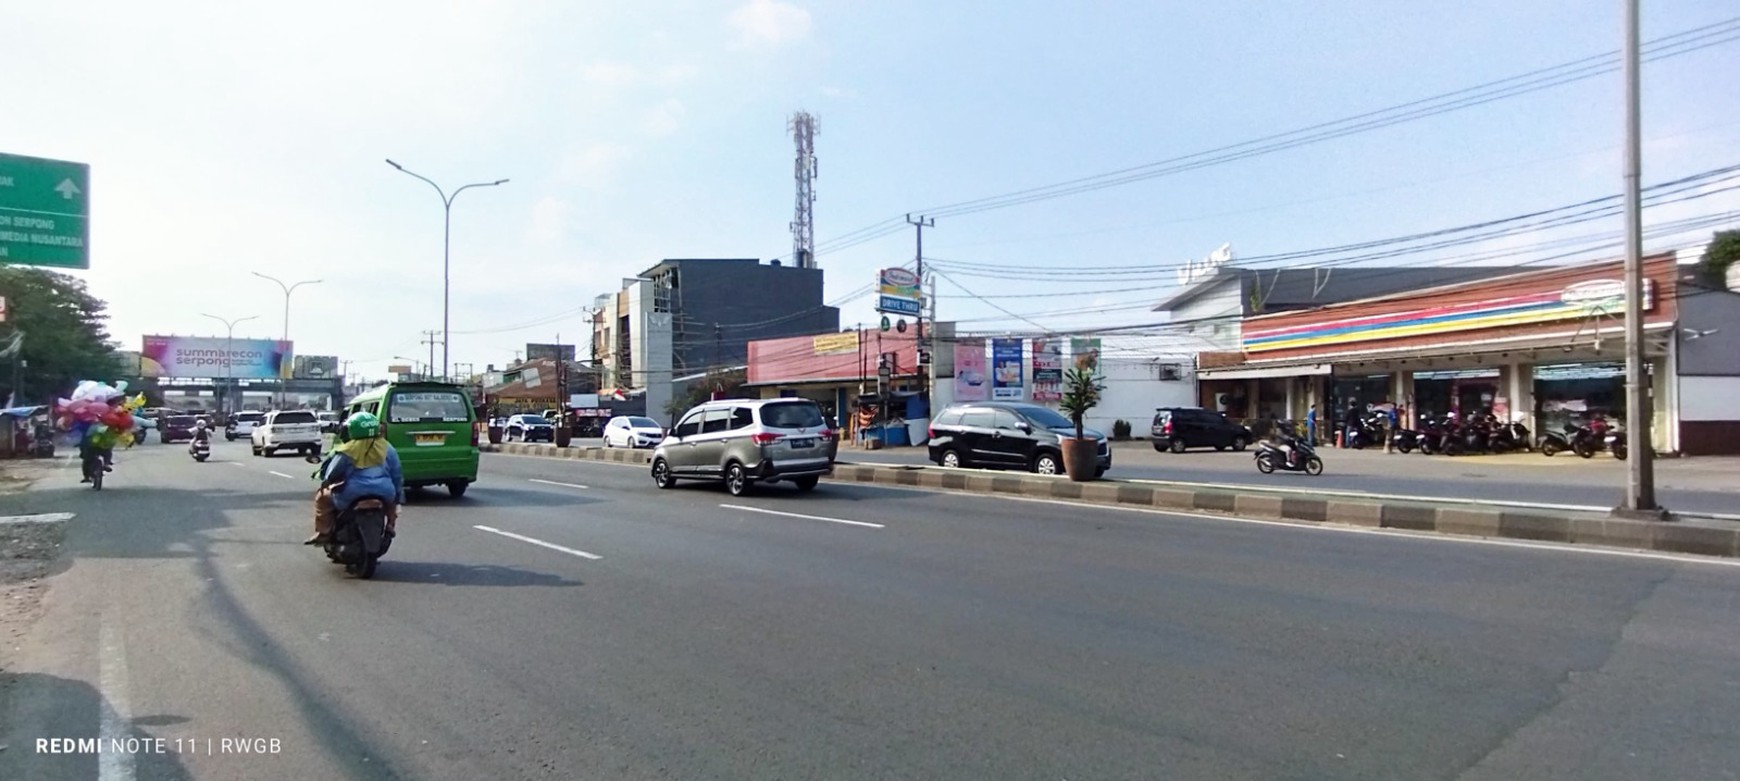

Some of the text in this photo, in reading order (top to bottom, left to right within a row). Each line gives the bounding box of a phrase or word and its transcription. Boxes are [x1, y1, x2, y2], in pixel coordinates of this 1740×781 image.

[13, 217, 55, 230] SERPONG
[31, 233, 83, 247] NUSANTARA
[883, 299, 918, 312] DRIVE THRU
[176, 347, 262, 358] summarecon
[176, 357, 230, 368] serpong
